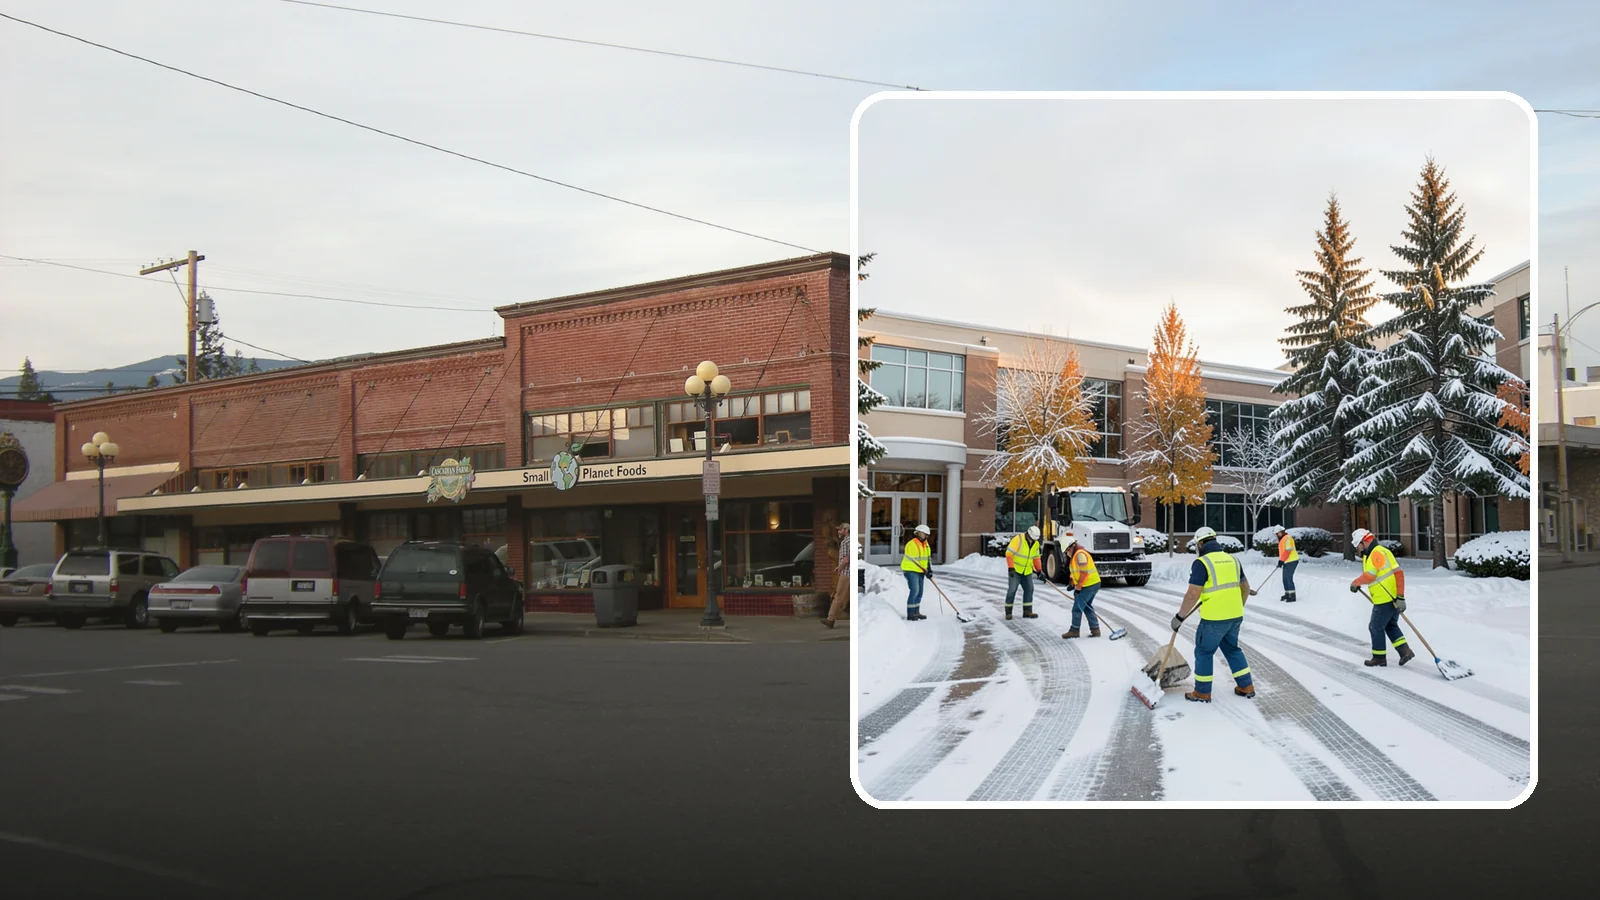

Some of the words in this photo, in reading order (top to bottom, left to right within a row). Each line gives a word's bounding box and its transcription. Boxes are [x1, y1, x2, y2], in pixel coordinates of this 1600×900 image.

[431, 467, 455, 476] CASCADIAN
[523, 471, 549, 483] Small
[583, 468, 614, 479] Planet
[617, 464, 647, 477] Foods
